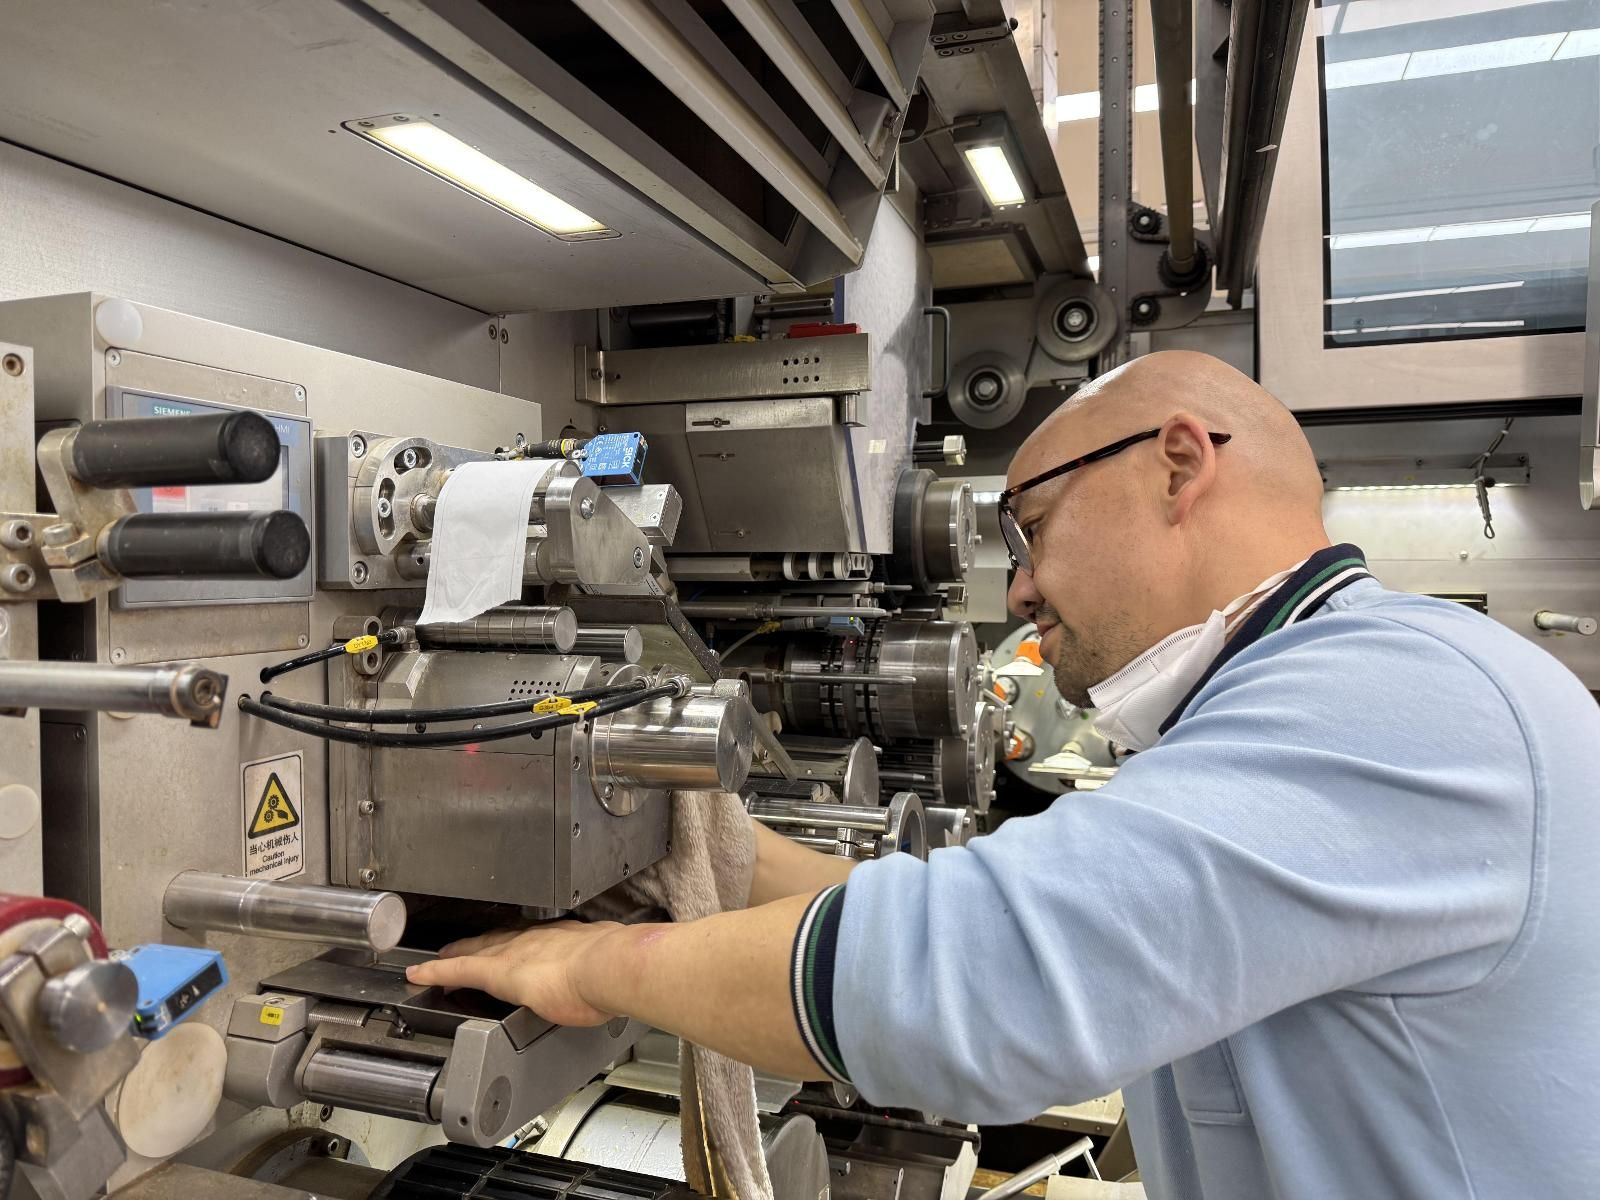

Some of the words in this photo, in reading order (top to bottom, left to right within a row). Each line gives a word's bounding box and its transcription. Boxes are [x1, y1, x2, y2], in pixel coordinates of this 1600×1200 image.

[622, 447, 634, 468] SICK
[249, 832, 299, 856] 当心机械伤人
[250, 859, 283, 876] mechanical
[283, 854, 299, 864] injury
[262, 851, 285, 862] Caution
